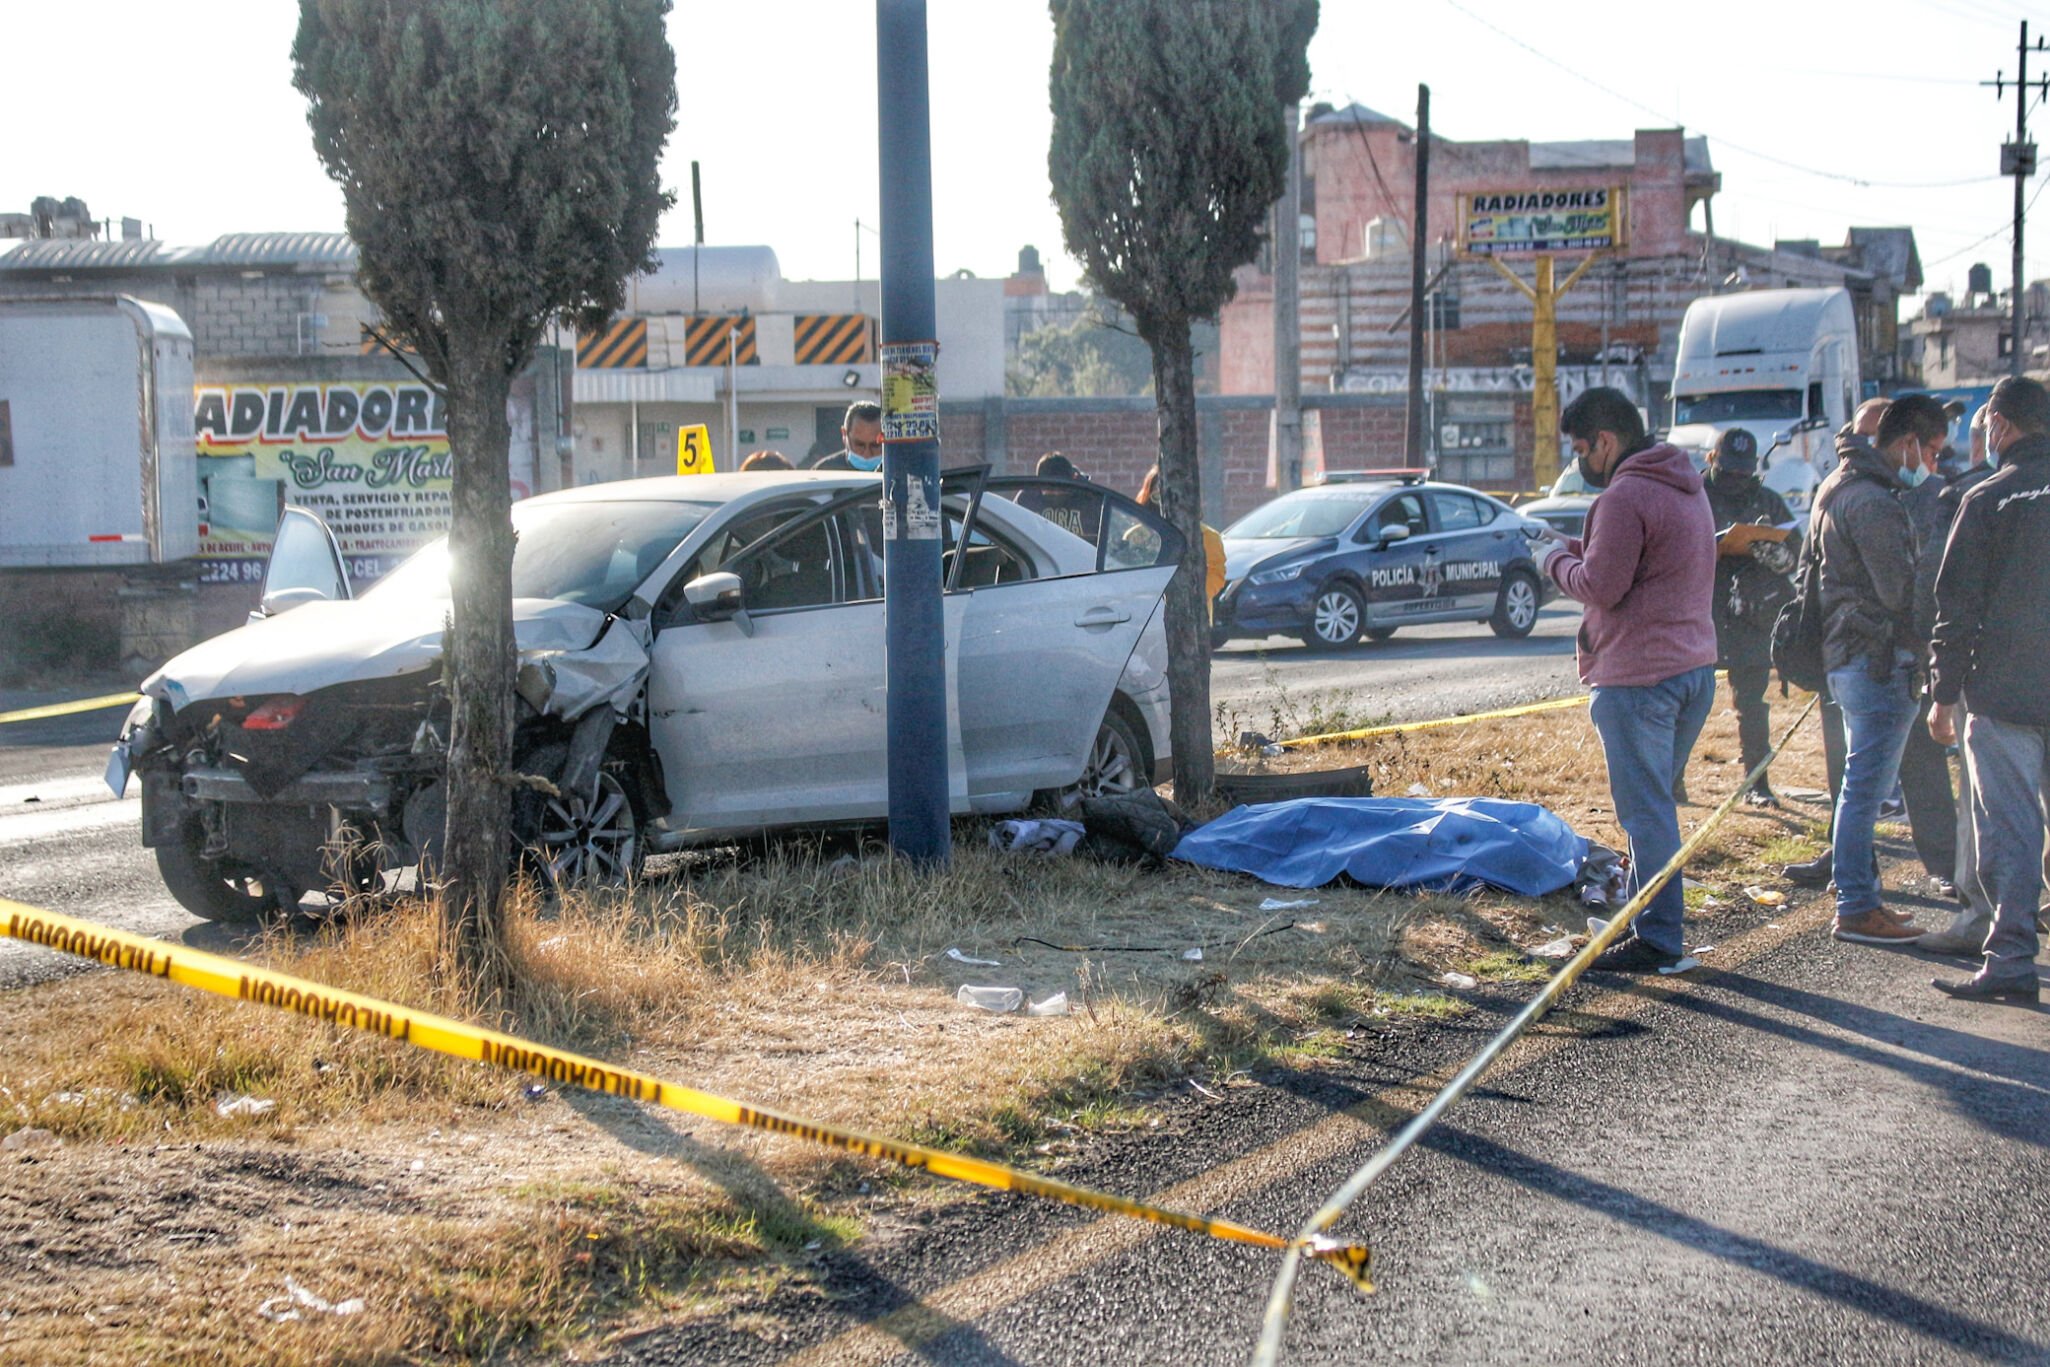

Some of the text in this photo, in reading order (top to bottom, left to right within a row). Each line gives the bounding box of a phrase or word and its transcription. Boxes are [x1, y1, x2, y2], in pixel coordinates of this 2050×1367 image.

[1514, 367, 1638, 408] VNTA
[683, 432, 697, 468] 5
[342, 492, 401, 505] SERVICIO
[402, 491, 411, 503] Y
[326, 508, 342, 520] DE
[389, 522, 405, 533] DE
[242, 561, 262, 580] 96
[1372, 561, 1502, 588] POLICÍA MUNICIPAL
